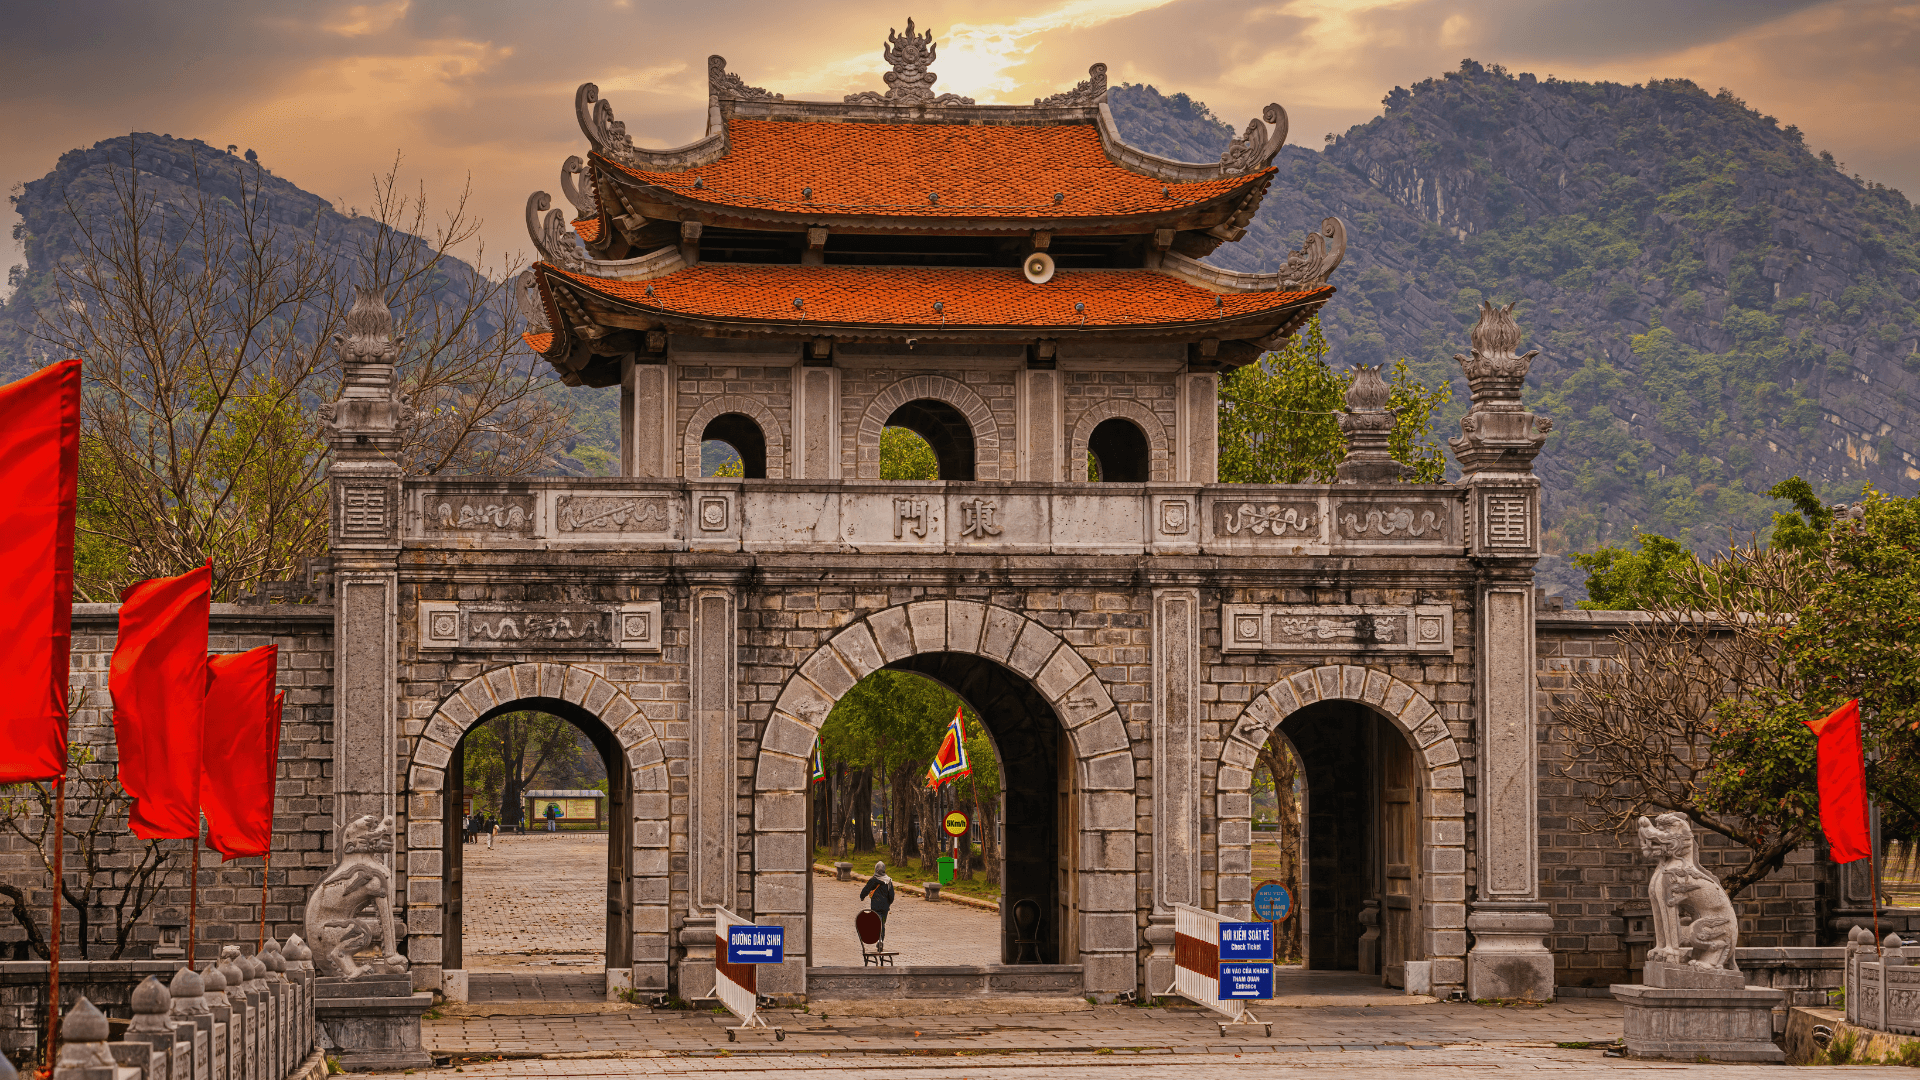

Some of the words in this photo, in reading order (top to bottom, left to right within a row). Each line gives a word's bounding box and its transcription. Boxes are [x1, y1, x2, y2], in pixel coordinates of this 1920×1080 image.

[946, 819, 966, 828] 5Km/h
[766, 934, 781, 946] SINH
[1231, 943, 1246, 951] Check
[1246, 943, 1262, 951] Ticket
